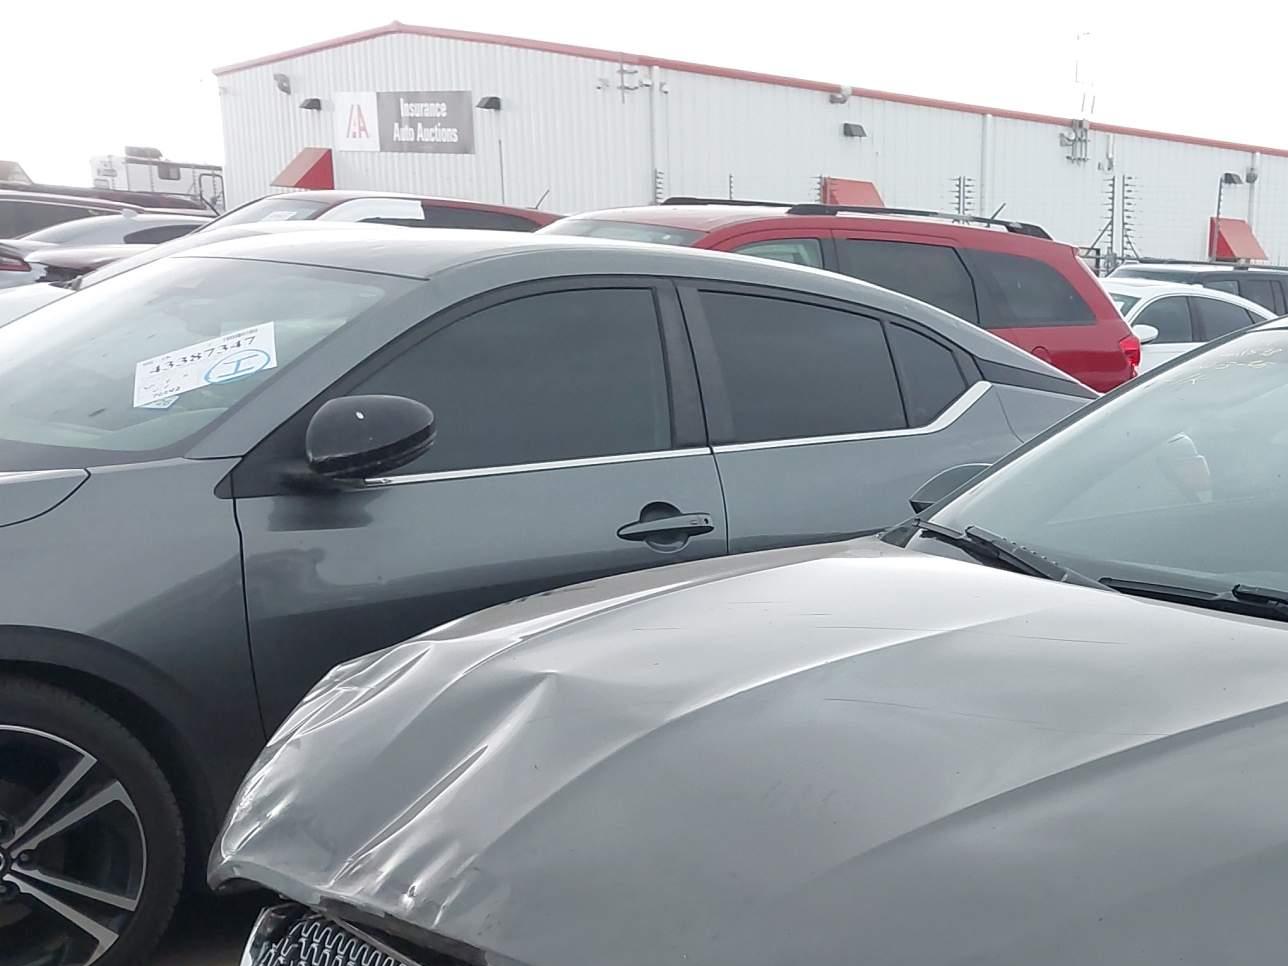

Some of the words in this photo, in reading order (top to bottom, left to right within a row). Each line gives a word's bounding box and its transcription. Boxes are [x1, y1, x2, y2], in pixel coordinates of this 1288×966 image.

[399, 97, 448, 118] Insurance
[393, 122, 415, 142] Auto
[416, 122, 459, 143] Auctions
